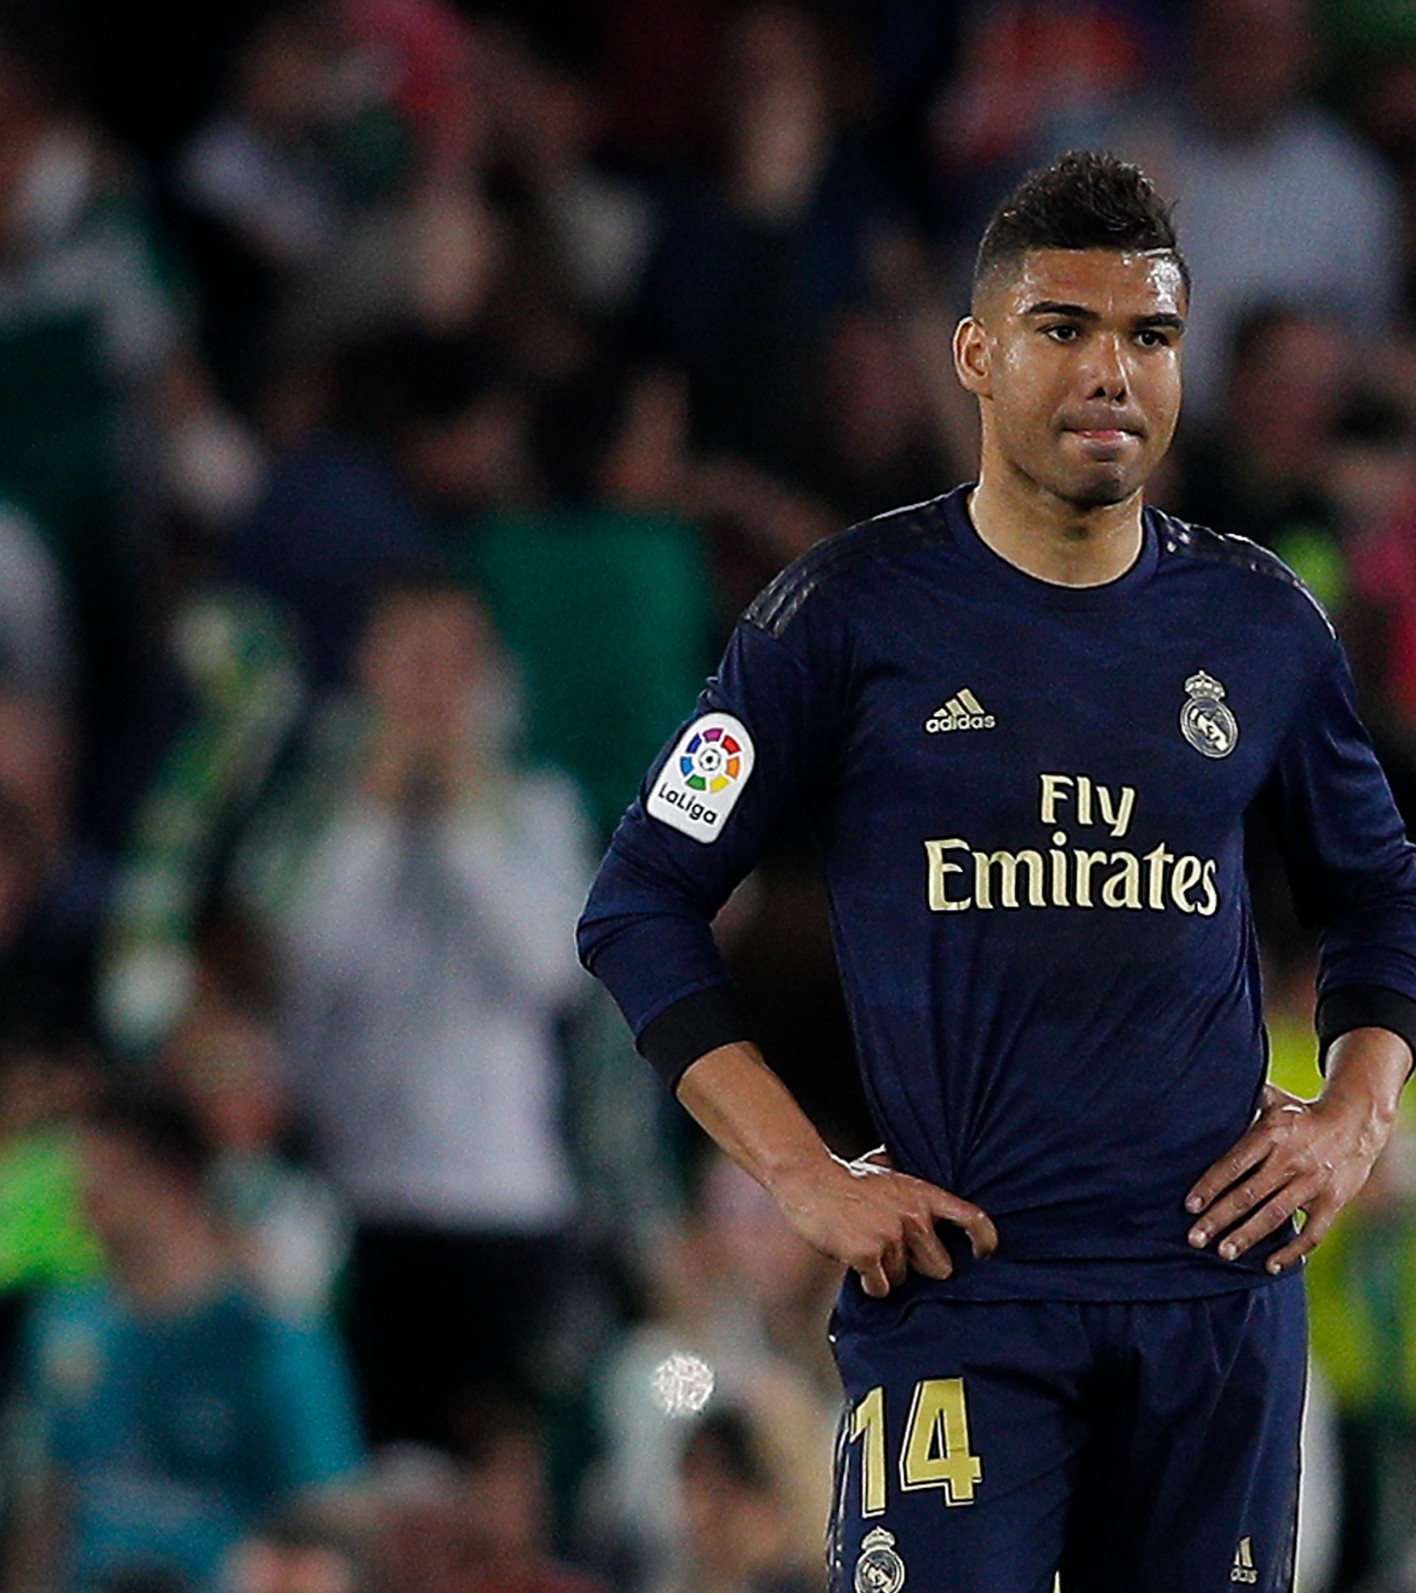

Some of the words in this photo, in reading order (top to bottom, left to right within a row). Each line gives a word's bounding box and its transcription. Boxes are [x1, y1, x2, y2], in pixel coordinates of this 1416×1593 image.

[926, 715, 996, 733] adidas
[658, 782, 718, 825] LaLiga
[1040, 774, 1135, 837] Fly
[923, 832, 1218, 917] Emirates
[849, 1376, 982, 1518] 14
